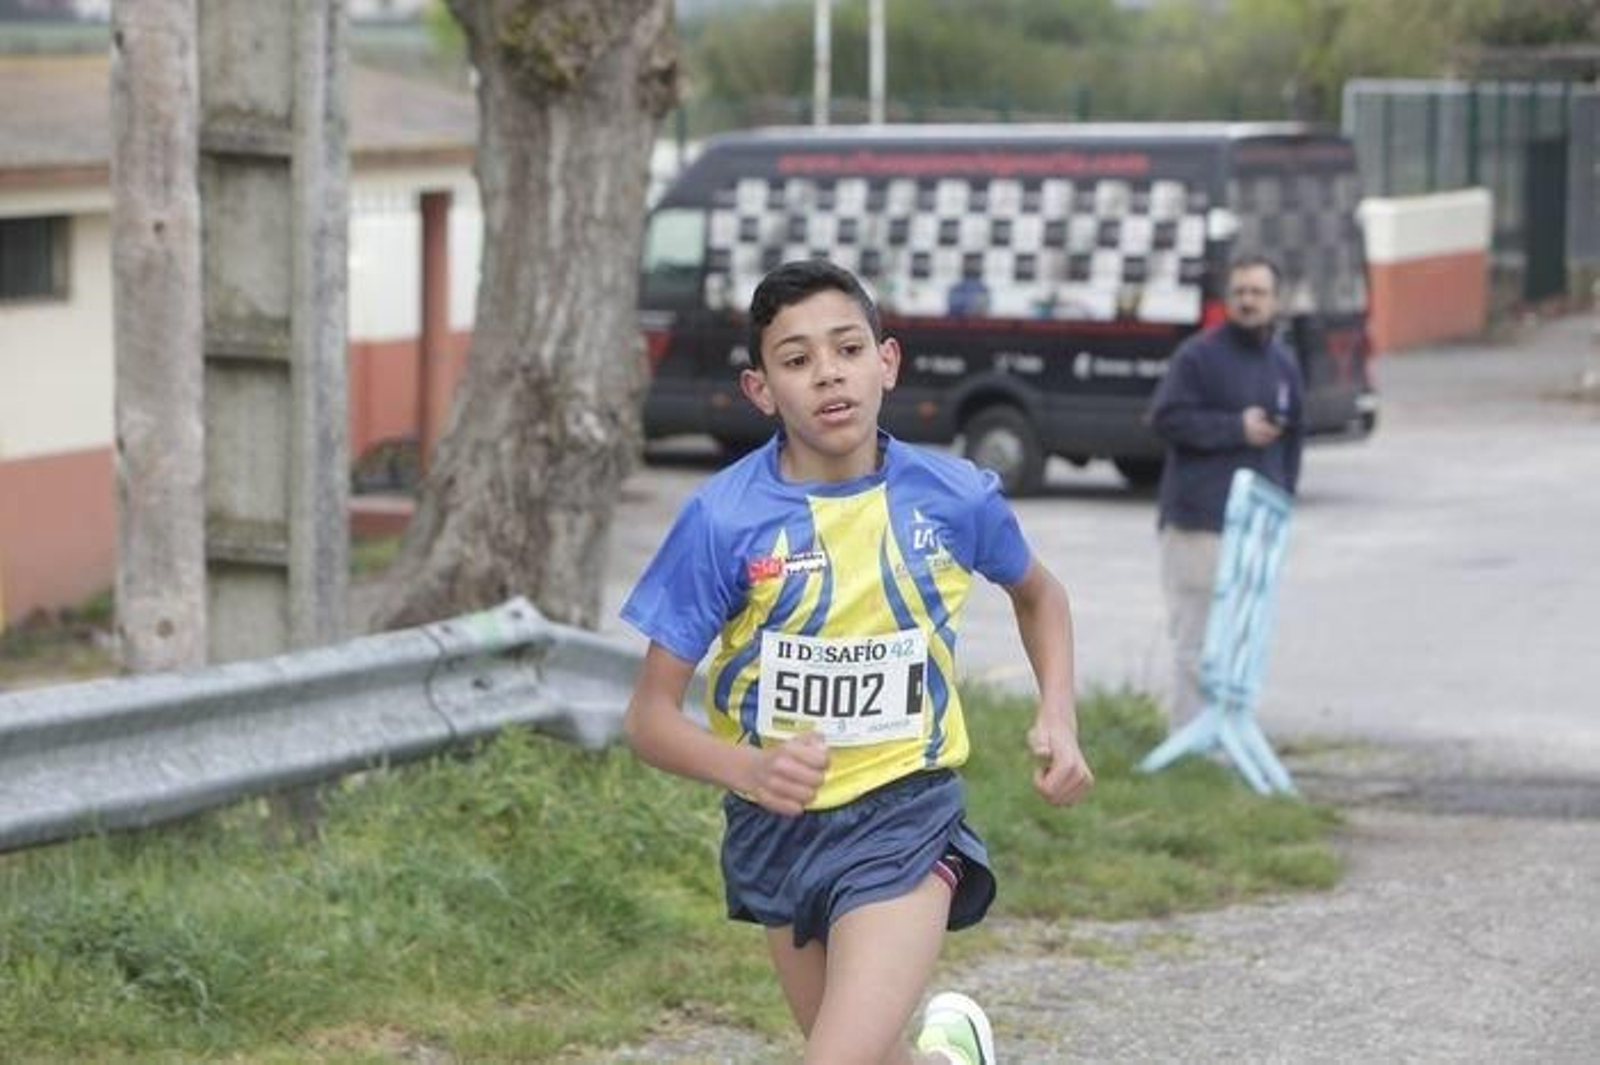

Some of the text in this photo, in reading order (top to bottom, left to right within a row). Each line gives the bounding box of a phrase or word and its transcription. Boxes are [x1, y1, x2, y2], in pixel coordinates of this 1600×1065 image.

[777, 641, 791, 659] II
[890, 639, 915, 659] 42
[774, 670, 885, 718] 5002
